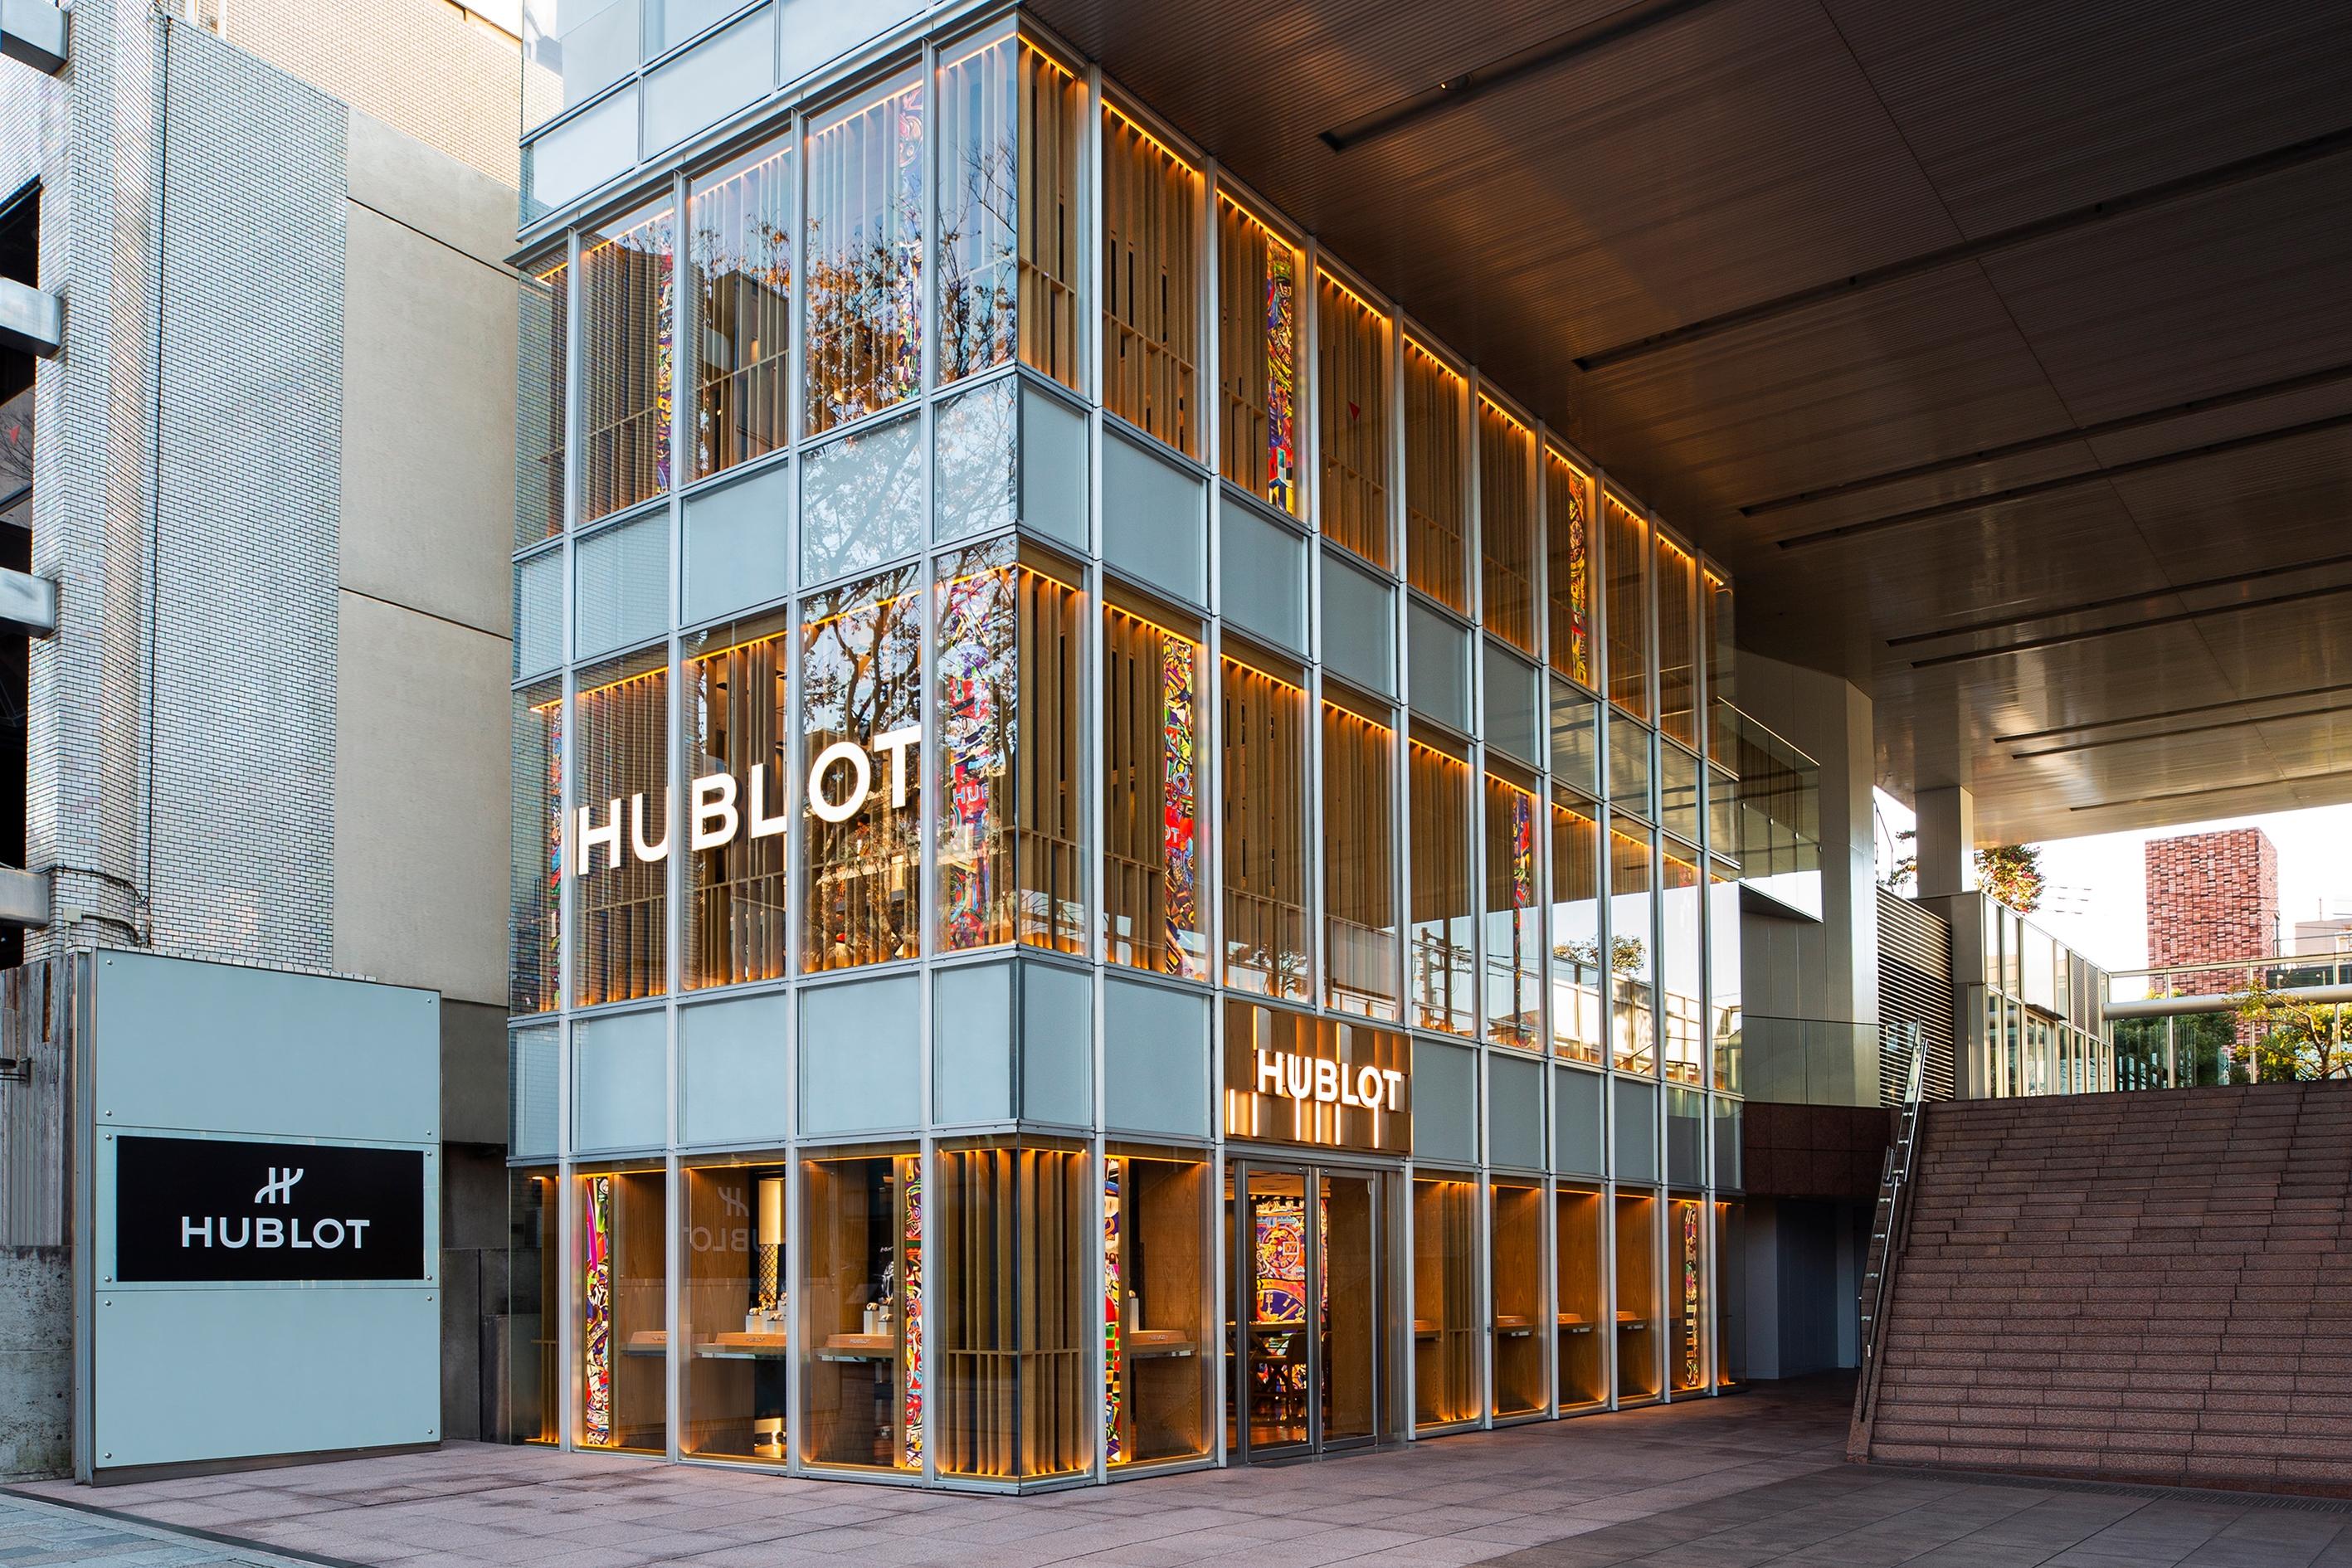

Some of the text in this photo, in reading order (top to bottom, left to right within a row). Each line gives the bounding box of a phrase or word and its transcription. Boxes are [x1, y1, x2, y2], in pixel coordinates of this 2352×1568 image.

[577, 725, 921, 875] HUBLOT
[1257, 1049, 1402, 1111] HUBLOT
[182, 1215, 370, 1249] HUBLOT
